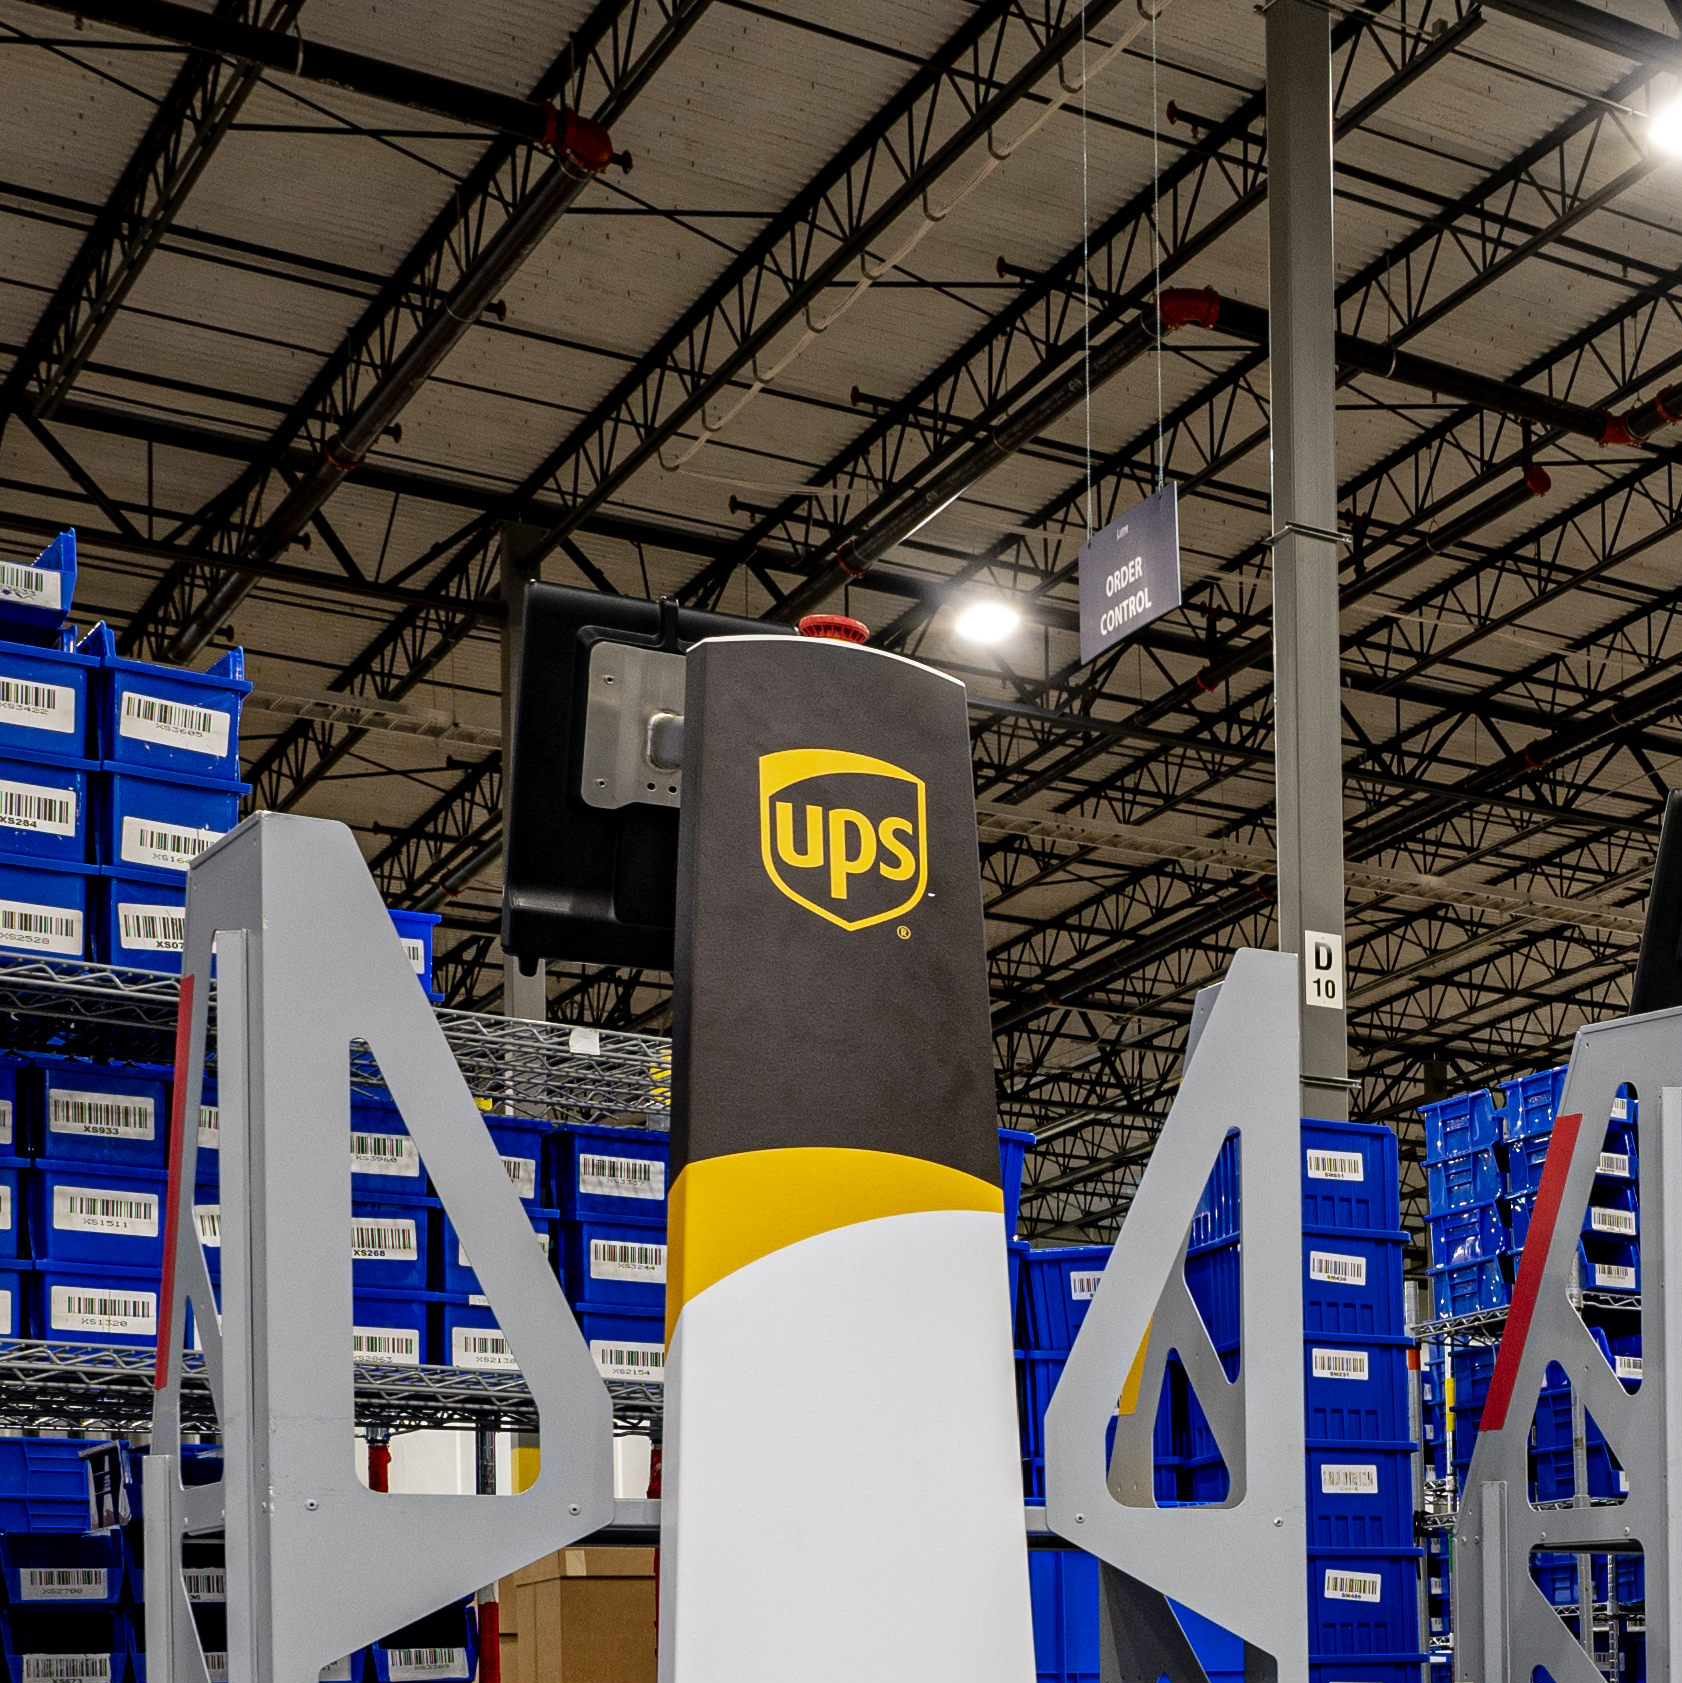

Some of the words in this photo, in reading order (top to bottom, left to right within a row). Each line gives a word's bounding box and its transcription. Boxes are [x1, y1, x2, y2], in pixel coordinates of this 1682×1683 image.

[1106, 556, 1143, 598] ORDER
[1100, 587, 1152, 636] CONTROL
[0, 702, 49, 716] XS3422
[155, 722, 204, 738] XS3605
[0, 815, 38, 829] XS284
[775, 801, 916, 900] ups
[0, 932, 50, 945] XS2528
[1315, 940, 1333, 971] D
[1312, 978, 1336, 1000] 10
[83, 1125, 119, 1136] XS933
[83, 1217, 127, 1229] XS1511
[353, 1249, 386, 1258] XS268
[81, 1317, 128, 1327] XS1320
[612, 1367, 650, 1376] XS2154
